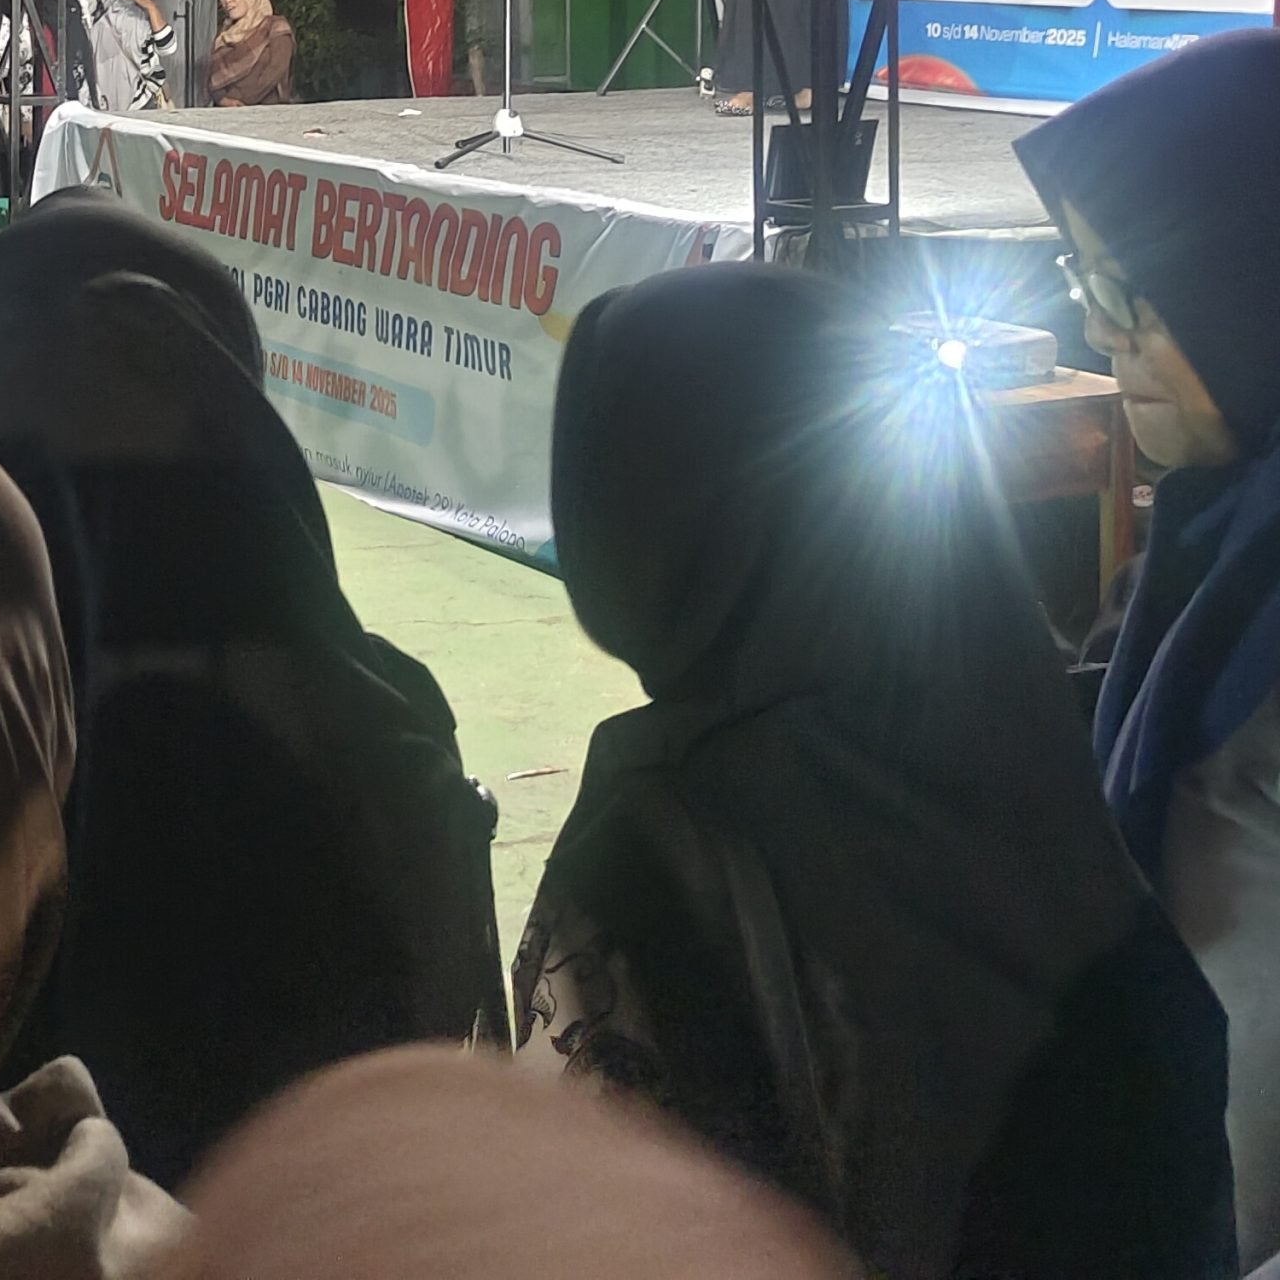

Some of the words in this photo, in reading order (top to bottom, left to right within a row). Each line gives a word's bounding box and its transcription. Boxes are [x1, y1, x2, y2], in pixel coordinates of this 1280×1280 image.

[926, 22, 941, 38] 10
[942, 23, 963, 39] s/d
[963, 24, 979, 39] 14
[979, 25, 1045, 44] November
[1044, 27, 1087, 47] 2025
[158, 148, 308, 251] SELAMAT
[311, 178, 562, 317] BERTANDING
[253, 272, 290, 315] PGRI
[296, 284, 368, 337] CABANG
[375, 305, 434, 359] WARA
[443, 324, 513, 382] TIMUR
[270, 351, 289, 382] S/D
[291, 358, 304, 386] 14
[305, 361, 367, 409] NOVEMBER
[369, 383, 398, 420] 2025
